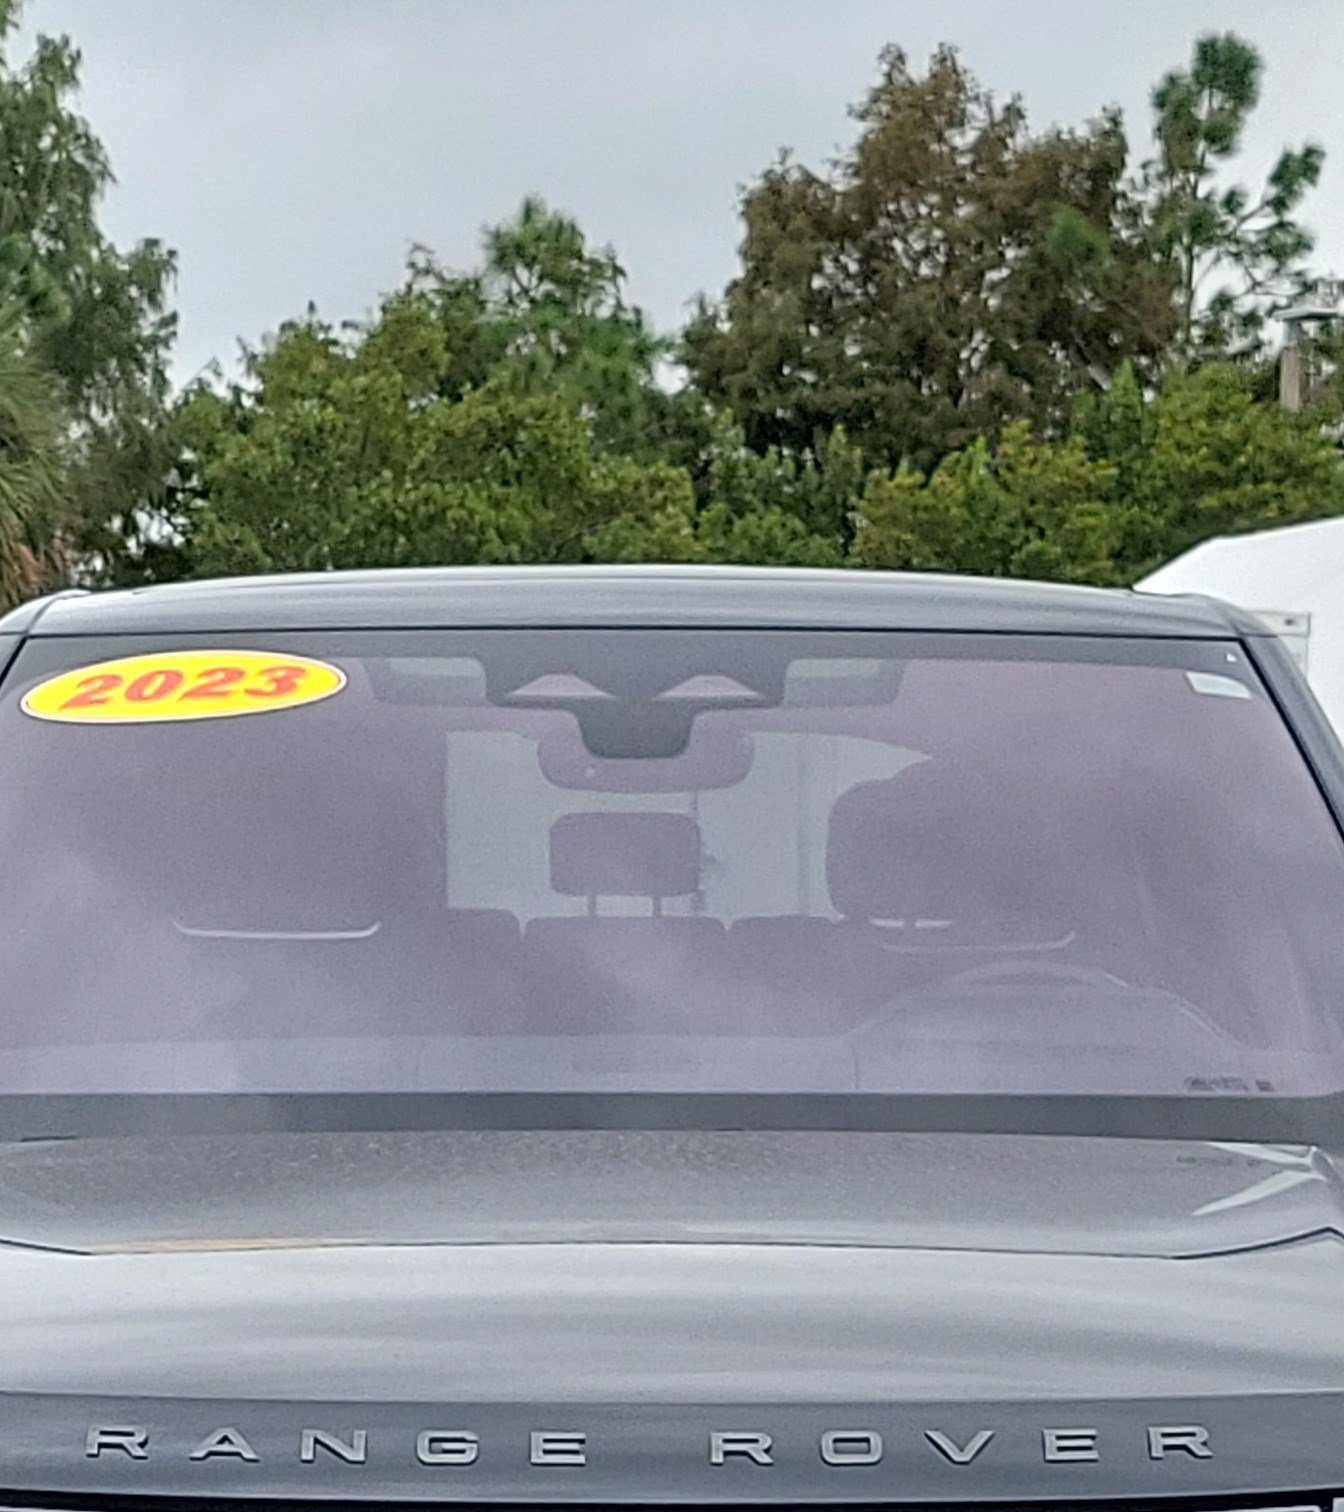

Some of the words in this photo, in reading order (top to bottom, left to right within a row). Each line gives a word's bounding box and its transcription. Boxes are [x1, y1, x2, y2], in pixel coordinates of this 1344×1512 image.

[58, 666, 308, 711] 2023
[85, 1424, 588, 1466] RANGE
[708, 1424, 1216, 1465] ROVER
